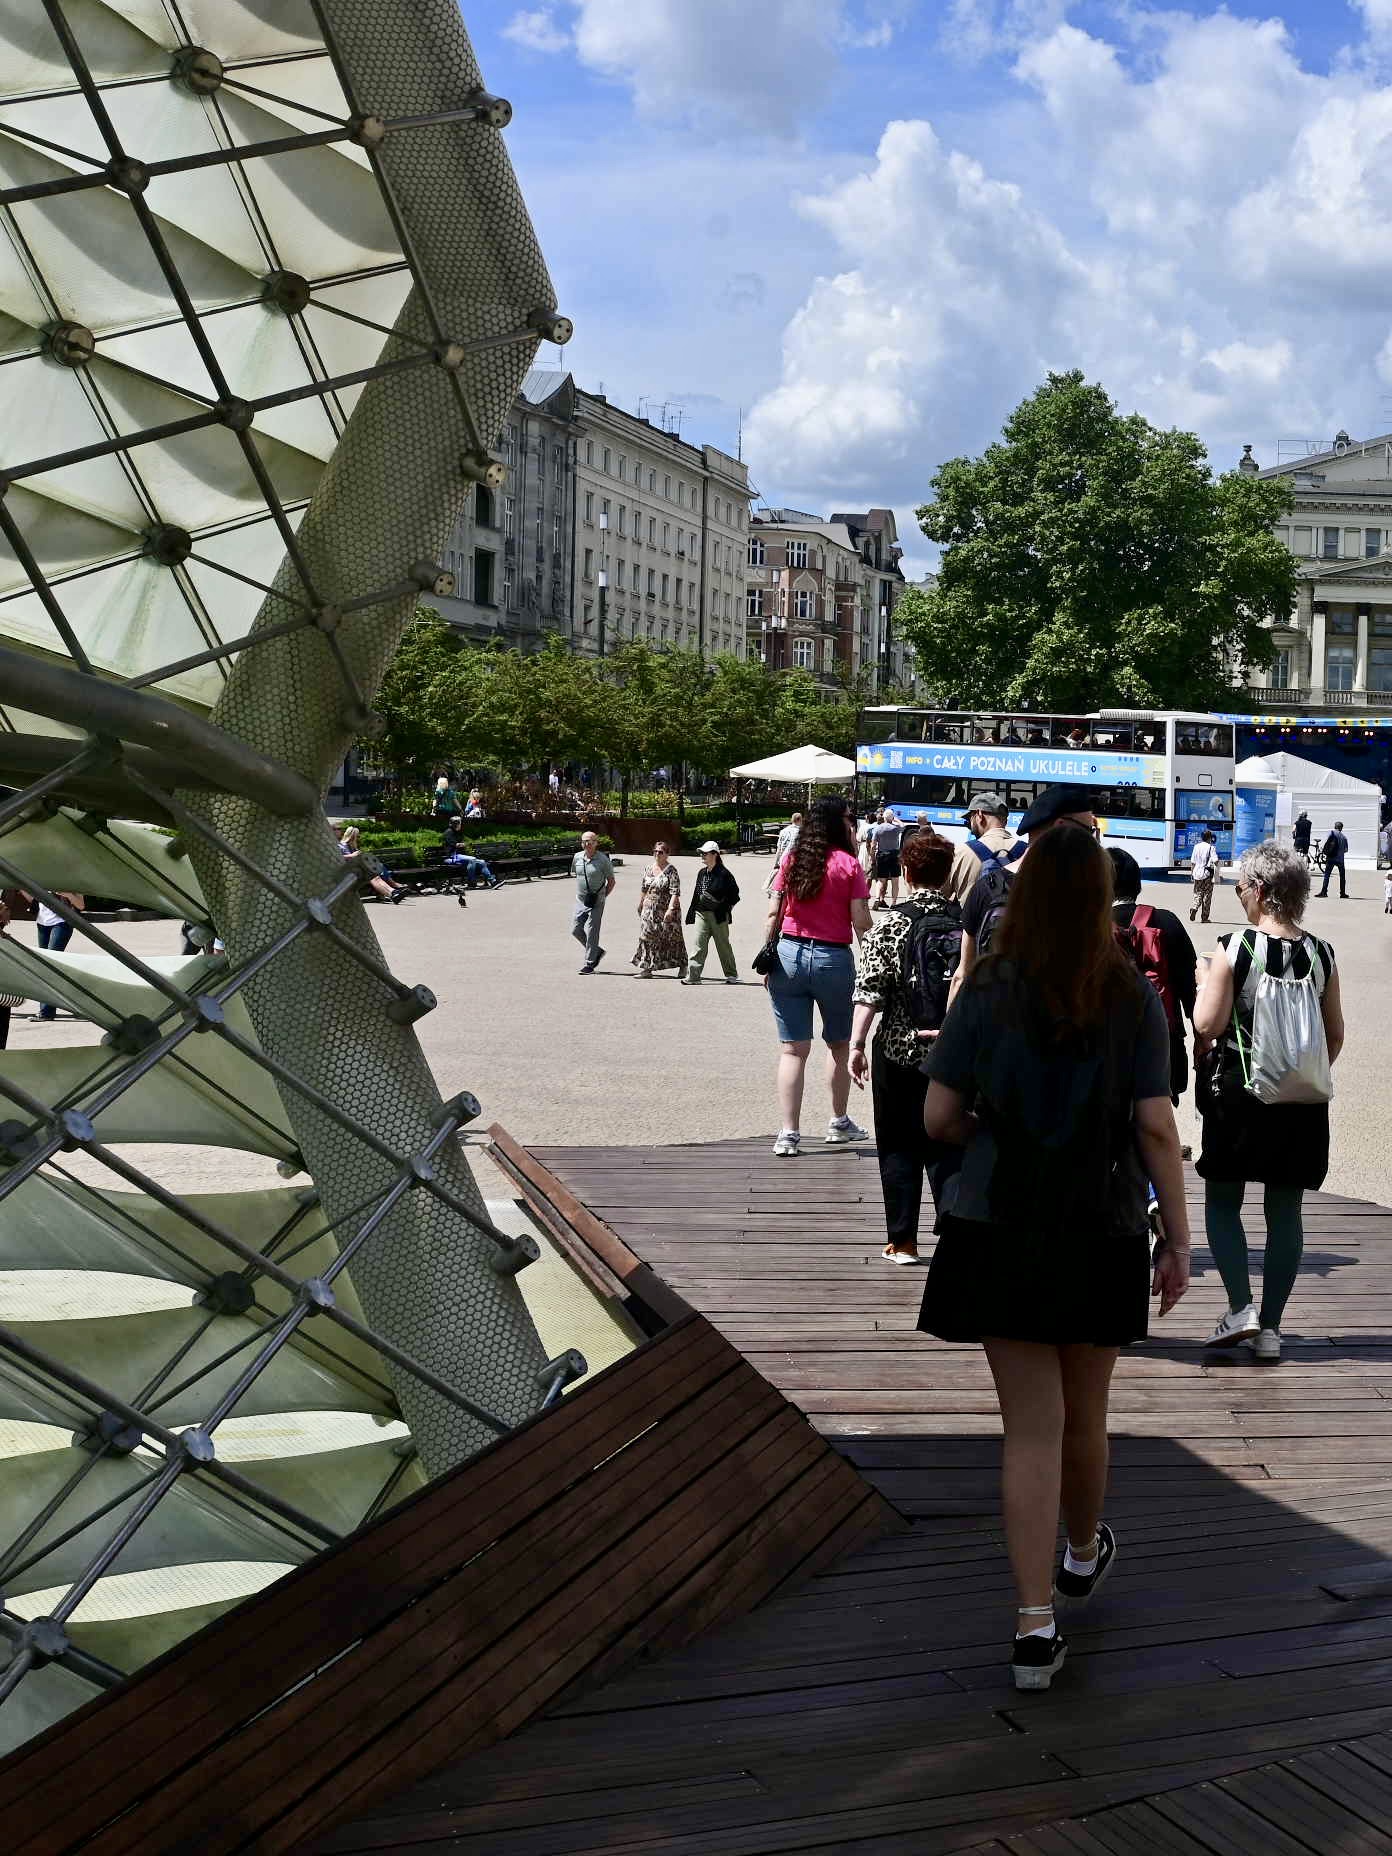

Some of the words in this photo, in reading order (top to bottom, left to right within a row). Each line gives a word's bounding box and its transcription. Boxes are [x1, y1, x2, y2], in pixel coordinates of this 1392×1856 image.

[933, 754, 965, 769] CAŁY
[970, 755, 1024, 772] POZNAŃ
[1030, 759, 1088, 776] UKULELE
